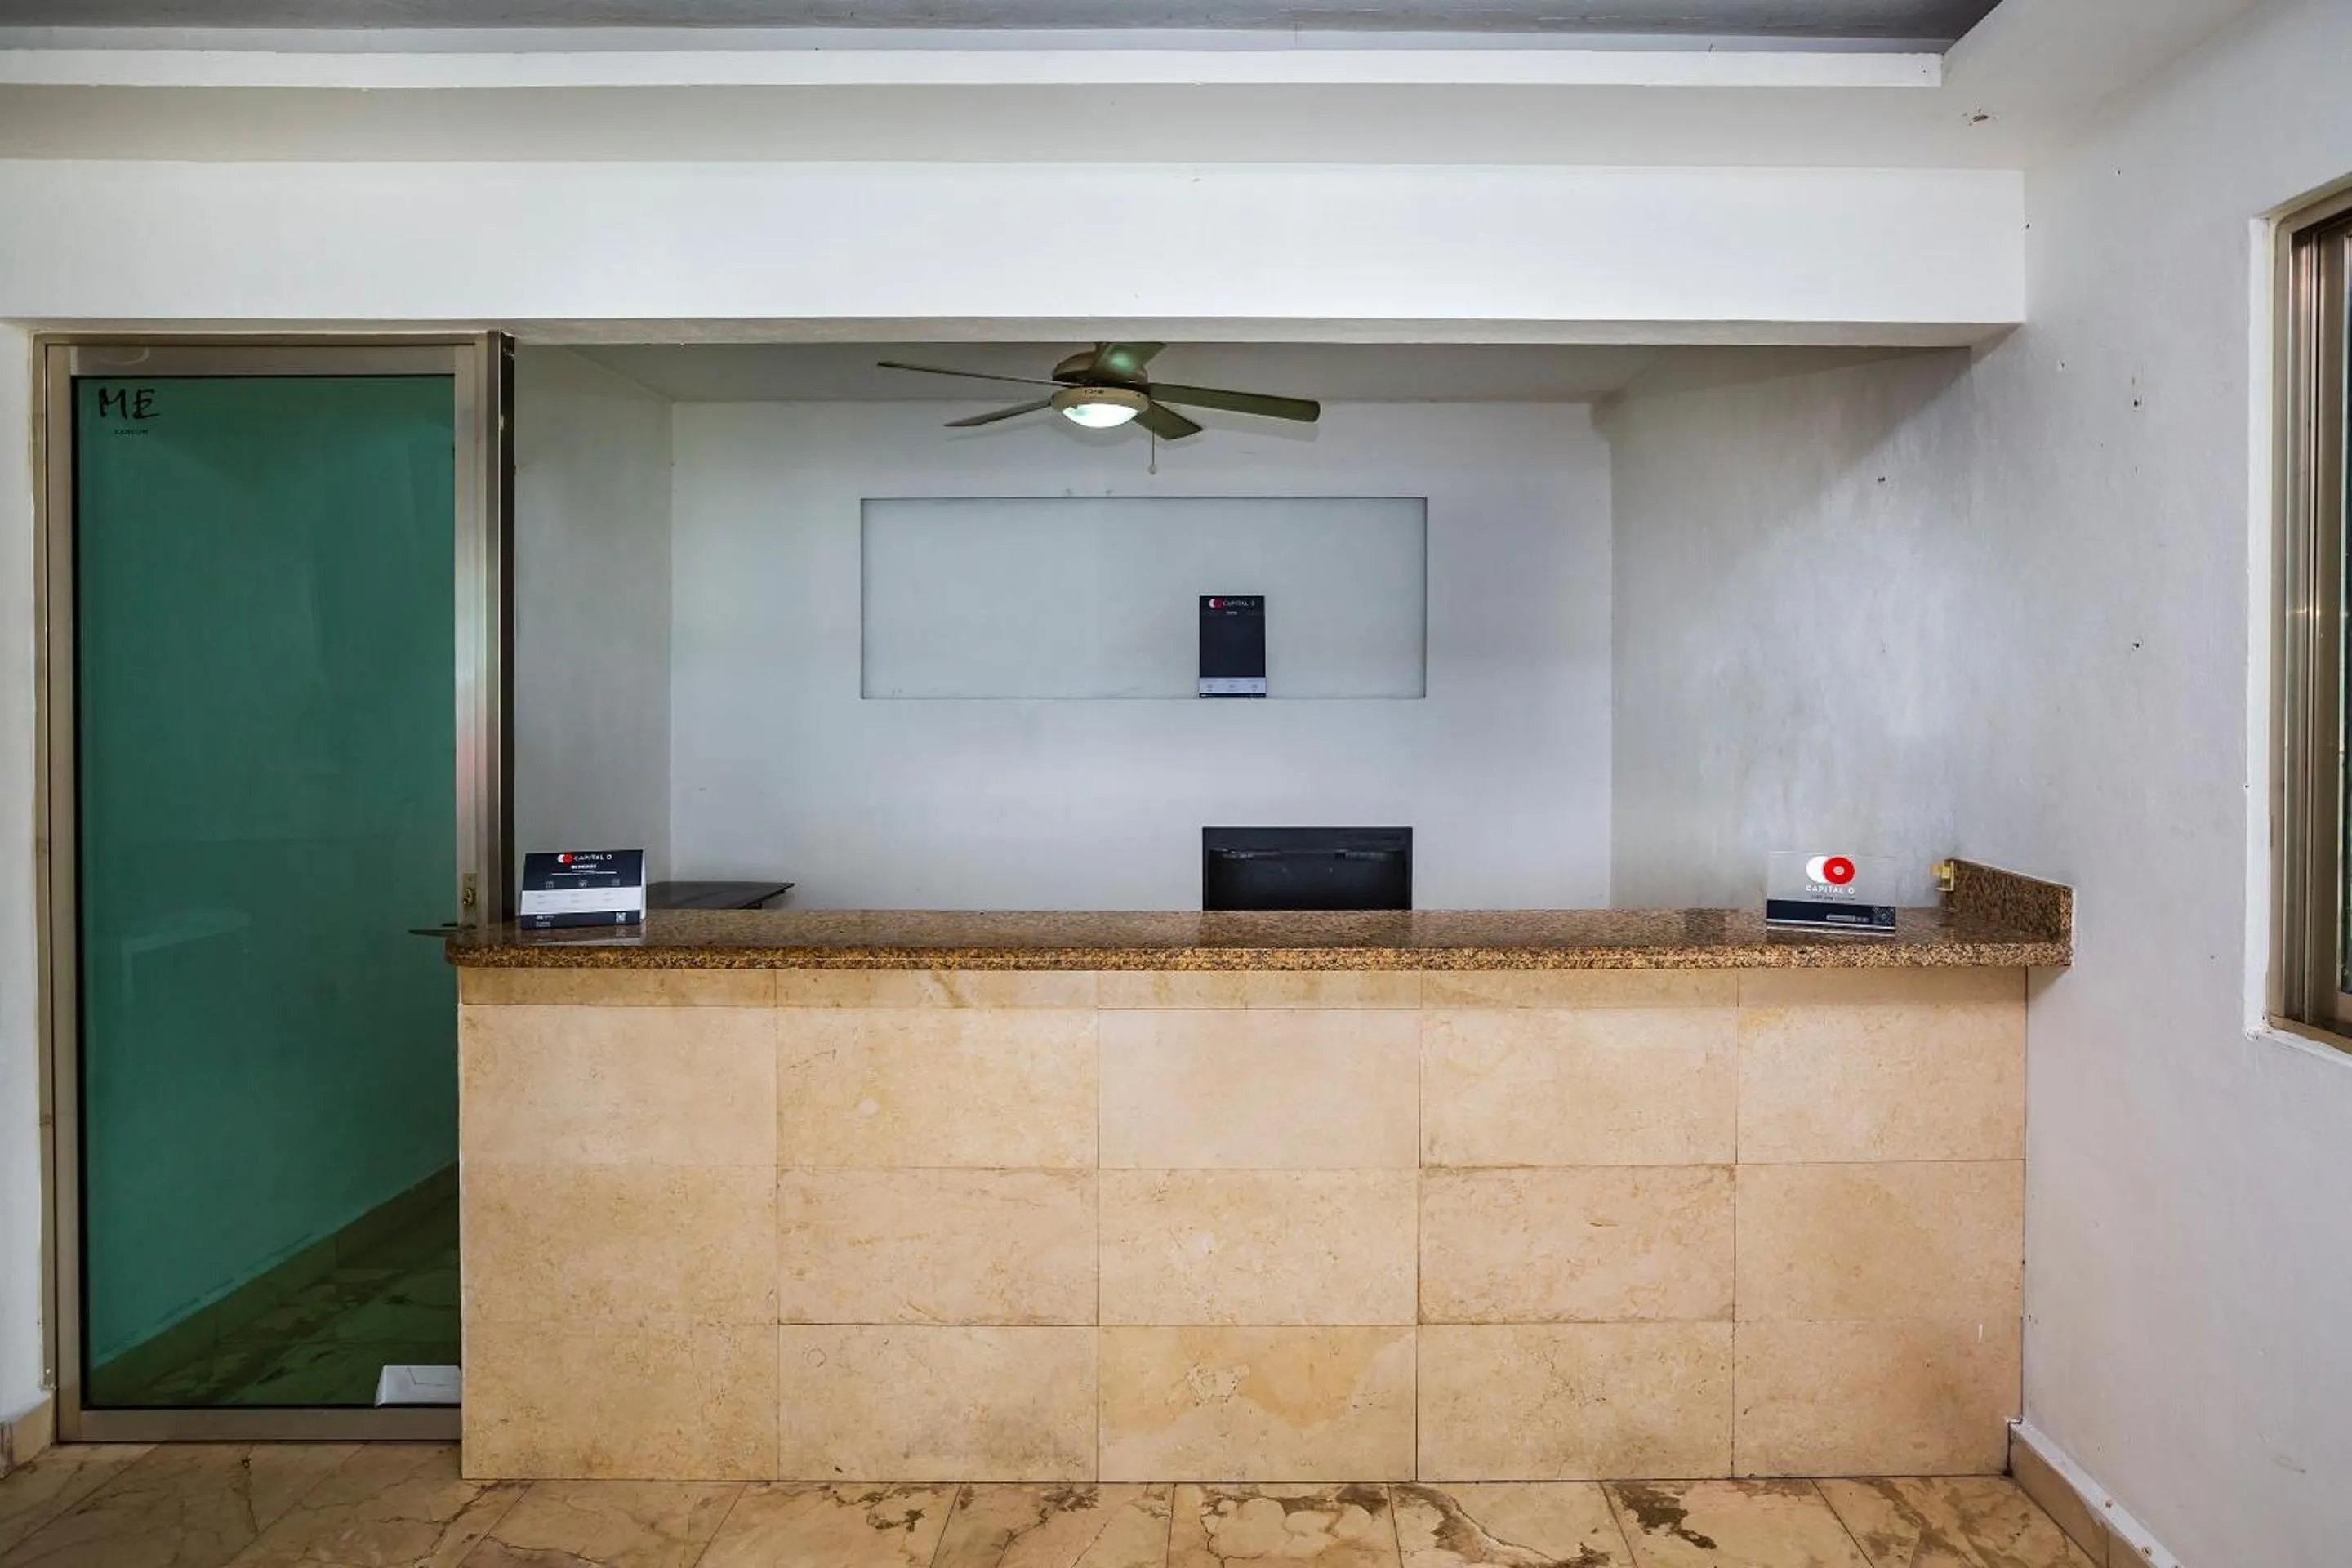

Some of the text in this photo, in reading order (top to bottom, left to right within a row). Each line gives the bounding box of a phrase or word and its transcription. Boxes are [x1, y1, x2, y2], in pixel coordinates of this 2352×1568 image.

[573, 853, 604, 862] CAPITAL
[1806, 884, 1855, 895] CAPITAL O
